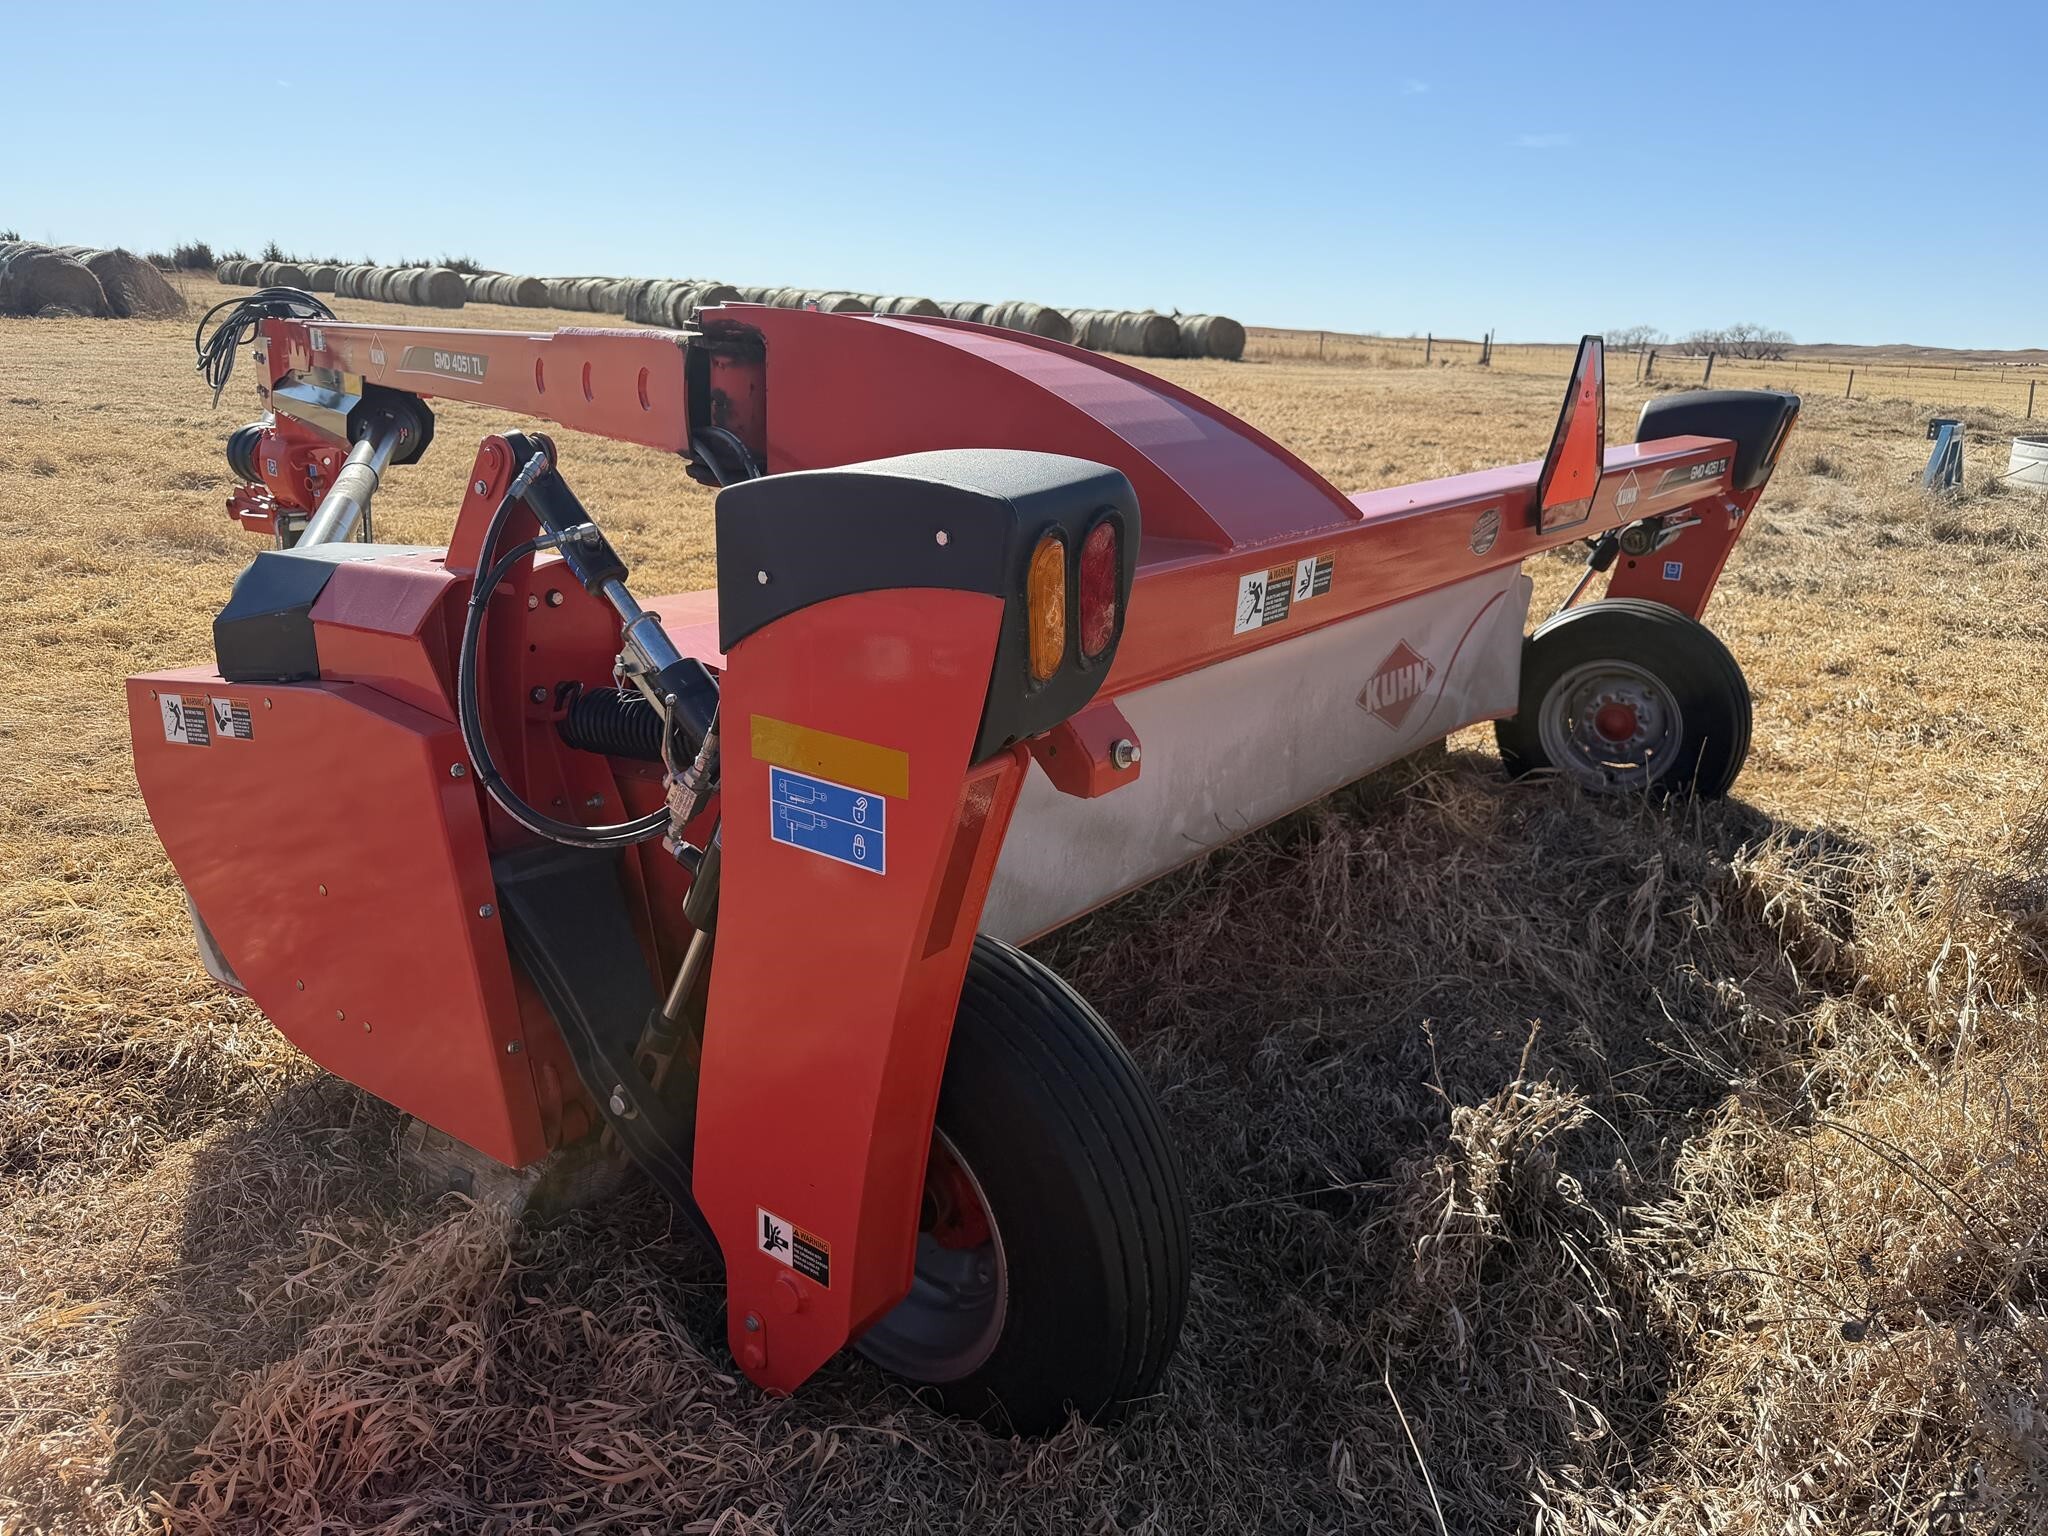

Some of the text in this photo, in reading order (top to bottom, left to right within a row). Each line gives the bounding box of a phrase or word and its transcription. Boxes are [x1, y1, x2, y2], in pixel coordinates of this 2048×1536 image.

[434, 352, 484, 376] GMD 4051 TL
[1616, 487, 1638, 507] KUHN
[1366, 658, 1429, 714] KUHN
[800, 1231, 828, 1253] WARNING
